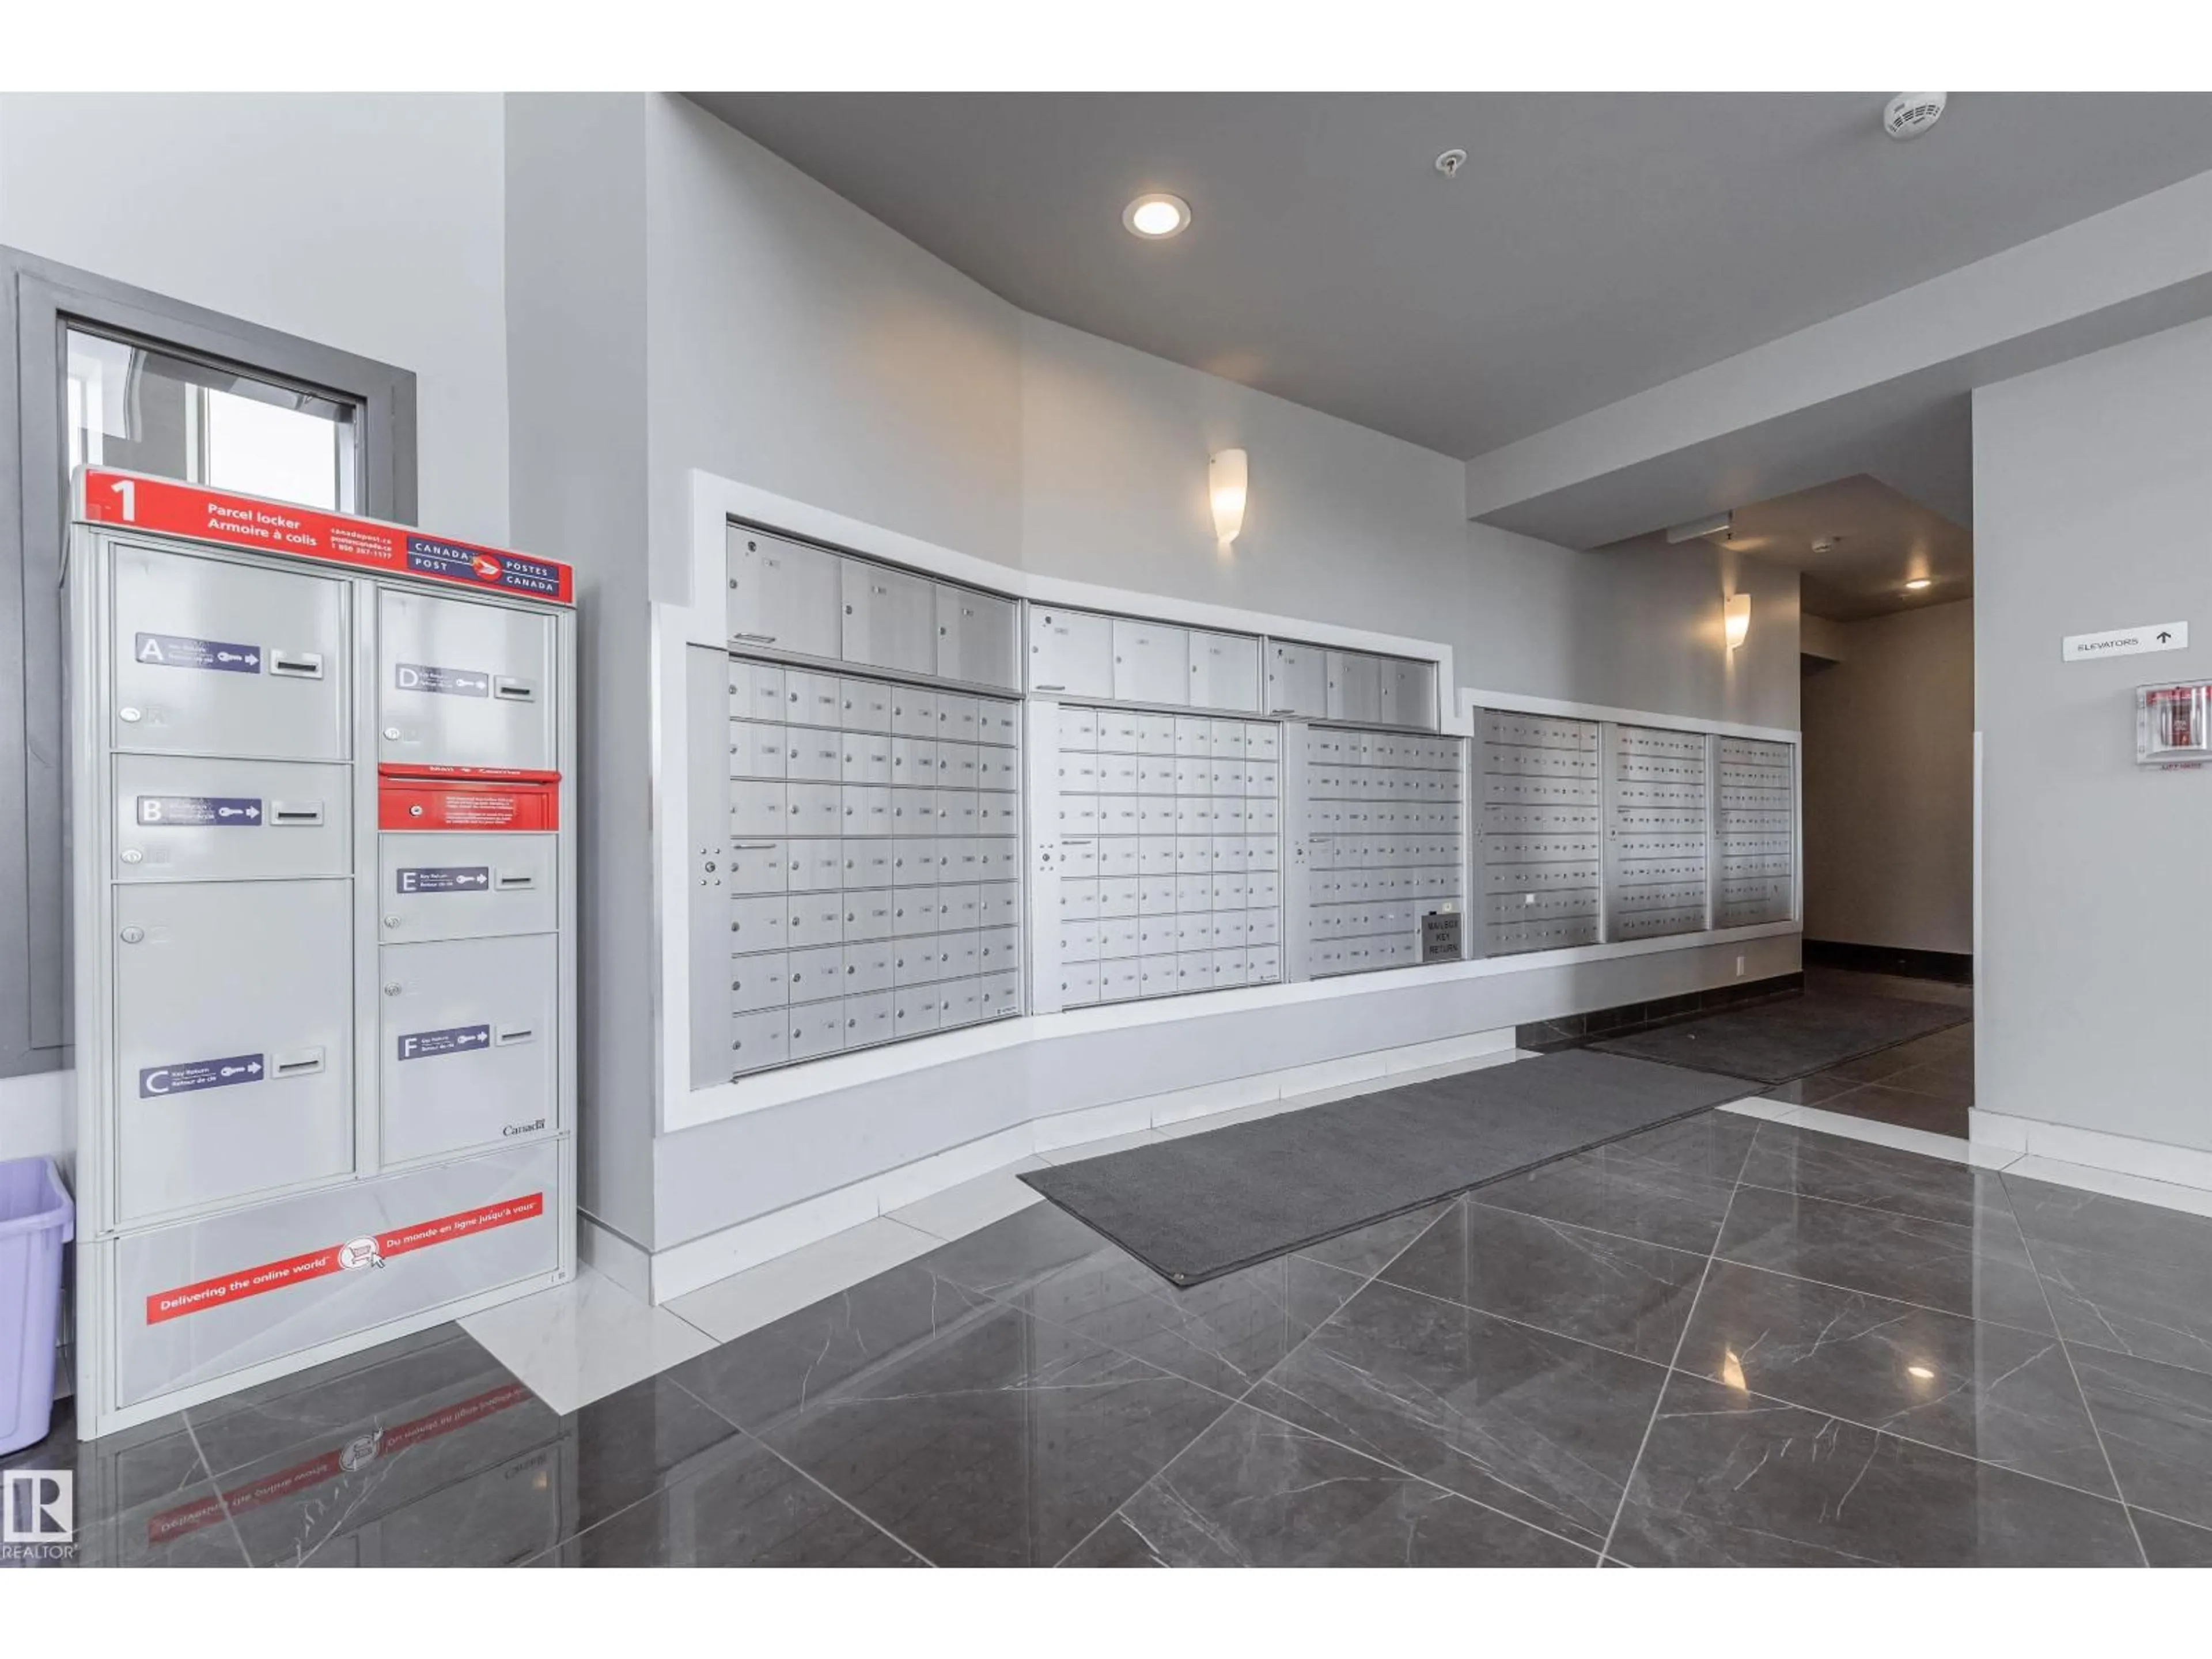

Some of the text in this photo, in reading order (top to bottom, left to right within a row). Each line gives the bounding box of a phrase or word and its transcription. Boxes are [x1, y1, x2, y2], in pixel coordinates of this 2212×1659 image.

[111, 480, 135, 521] 1
[208, 502, 301, 529] Parcel locker
[208, 518, 317, 547] Armoire à colis
[415, 543, 468, 561] CANADA
[415, 558, 447, 571] POST
[507, 560, 548, 576] POSTES
[507, 575, 553, 591] CANADA
[140, 639, 164, 661] A
[2077, 638, 2139, 652] ELEVATORS
[399, 668, 419, 687] D
[143, 800, 162, 821] B
[403, 872, 417, 891] E
[1427, 920, 1459, 930] MAILBOX
[1436, 932, 1450, 942] KEY
[1429, 944, 1459, 955] RETURN
[404, 1038, 418, 1058] F
[146, 1070, 169, 1093] C
[502, 1118, 546, 1137] Canada
[387, 1237, 400, 1248] Du
[403, 1228, 438, 1244] monde
[440, 1225, 452, 1233] en
[454, 1218, 477, 1231] ligne
[479, 1207, 512, 1224] jusqu'à
[160, 1285, 226, 1311] Delivering
[229, 1279, 250, 1291] the
[252, 1267, 290, 1285] online
